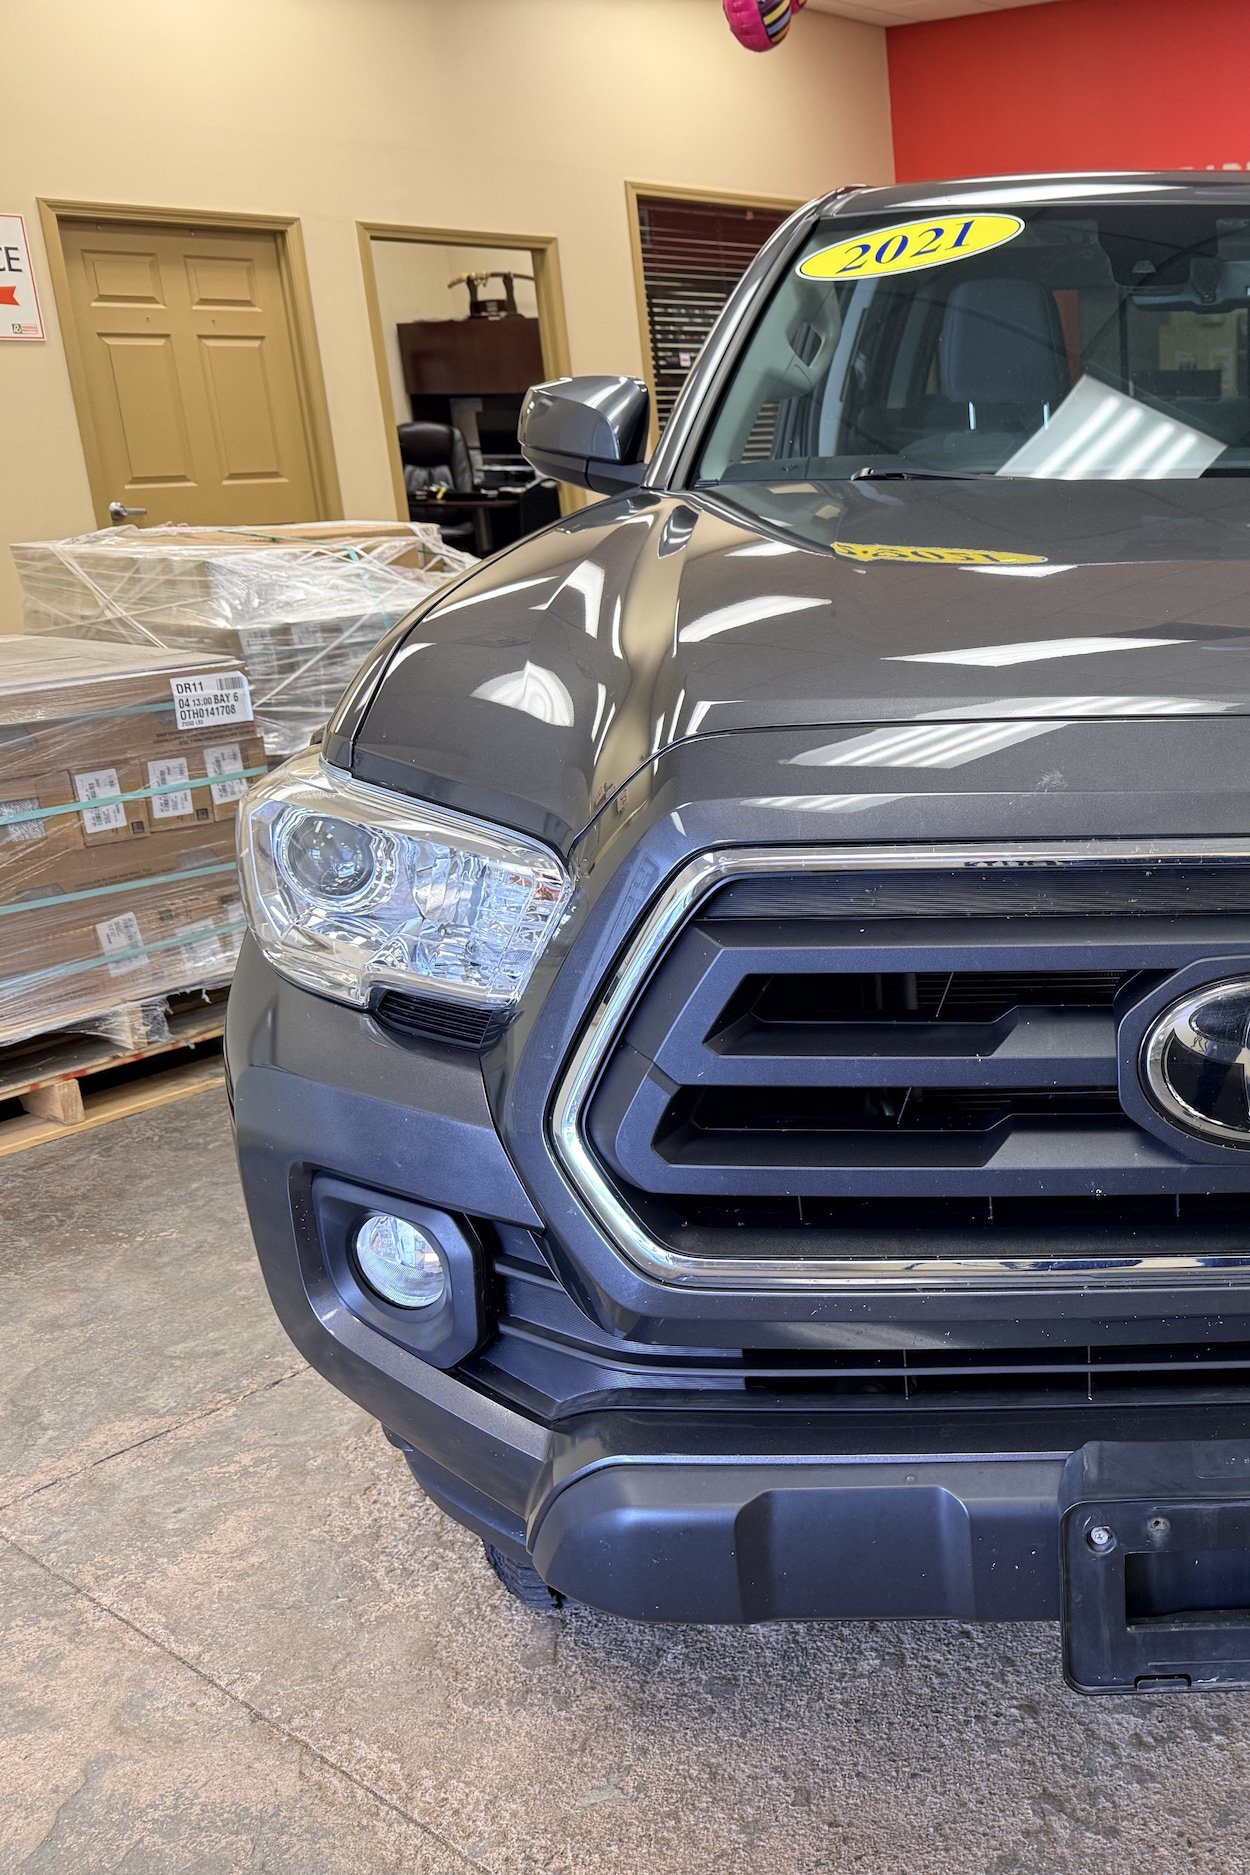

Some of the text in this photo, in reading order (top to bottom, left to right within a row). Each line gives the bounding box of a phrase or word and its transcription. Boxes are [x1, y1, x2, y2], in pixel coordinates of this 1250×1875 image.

[835, 219, 976, 275] 2021
[175, 681, 204, 694] DR11
[178, 692, 239, 709] 04 13:00 BAY 6
